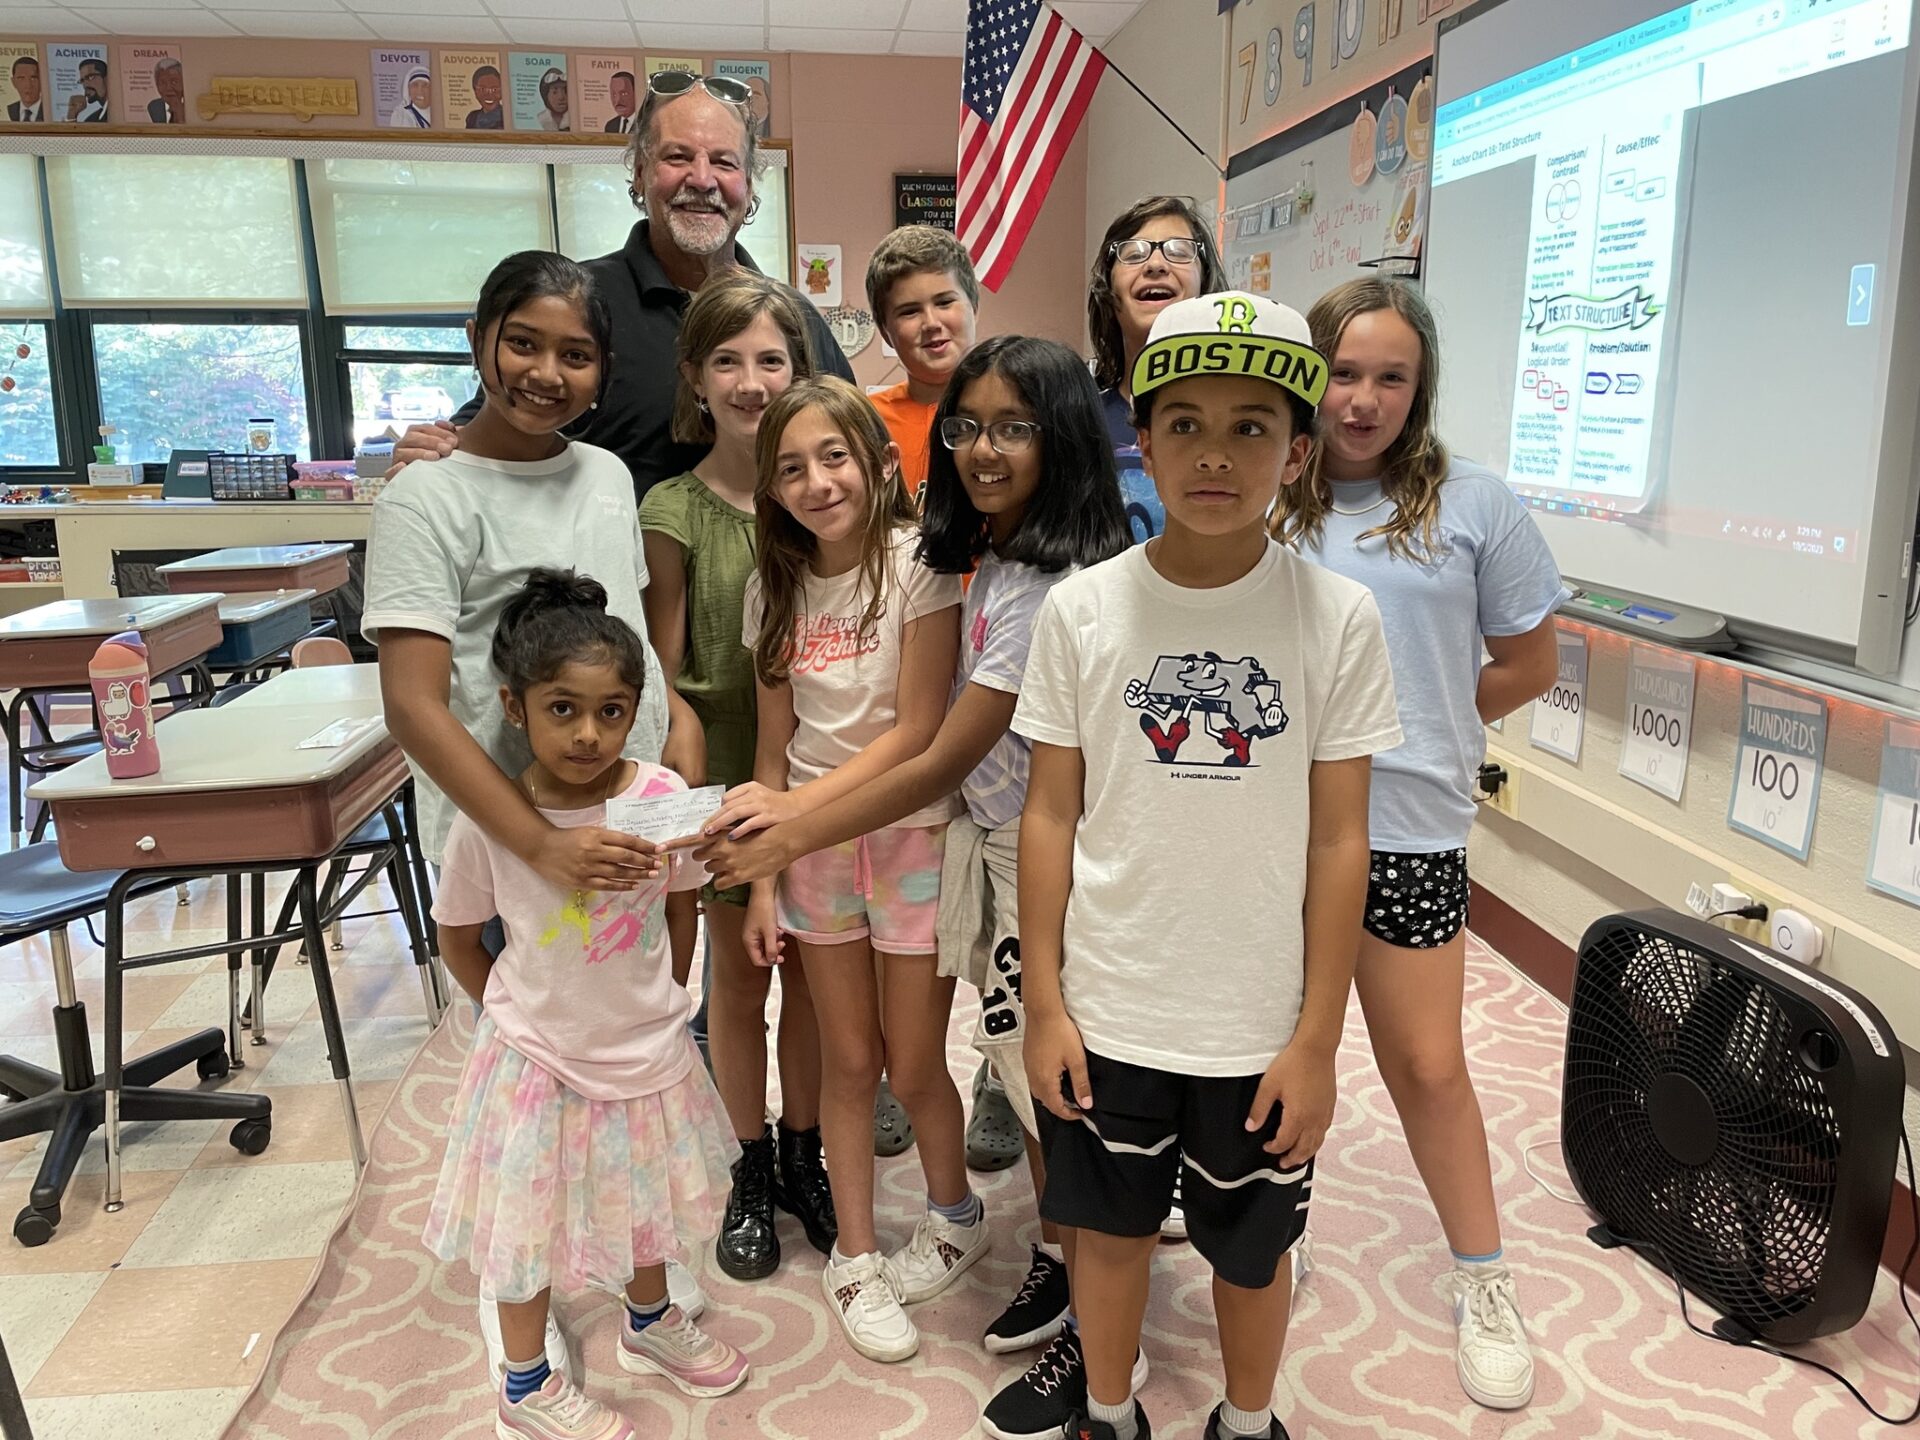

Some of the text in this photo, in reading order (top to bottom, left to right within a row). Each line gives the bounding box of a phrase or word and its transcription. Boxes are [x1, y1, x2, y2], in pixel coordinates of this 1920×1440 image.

[55, 49, 100, 58] ACHIEVE
[133, 50, 168, 59] DREAM
[380, 54, 421, 64] DEVOTE
[443, 56, 496, 65] ADVOCATE
[525, 58, 551, 66] SOAR
[1264, 27, 1282, 107] 8
[1294, 2, 1314, 87] 9
[591, 60, 620, 69] FAITH
[658, 62, 690, 71] STAND
[719, 65, 763, 75] DILIGENT
[219, 86, 351, 106] DECOTEAU
[1511, 131, 1542, 149] Structure
[900, 192, 956, 209] CLASSROO
[923, 210, 939, 218] YOU
[1213, 296, 1259, 334] B
[1548, 304, 1572, 324] TEXT
[842, 317, 860, 346] D
[1147, 342, 1320, 392] BOSTON
[1634, 667, 1688, 708] THOUSANDS
[1538, 686, 1580, 714] 0,000
[1633, 703, 1681, 748] 1,000
[1748, 706, 1816, 755] HUNDREDS
[1752, 749, 1799, 801] 100
